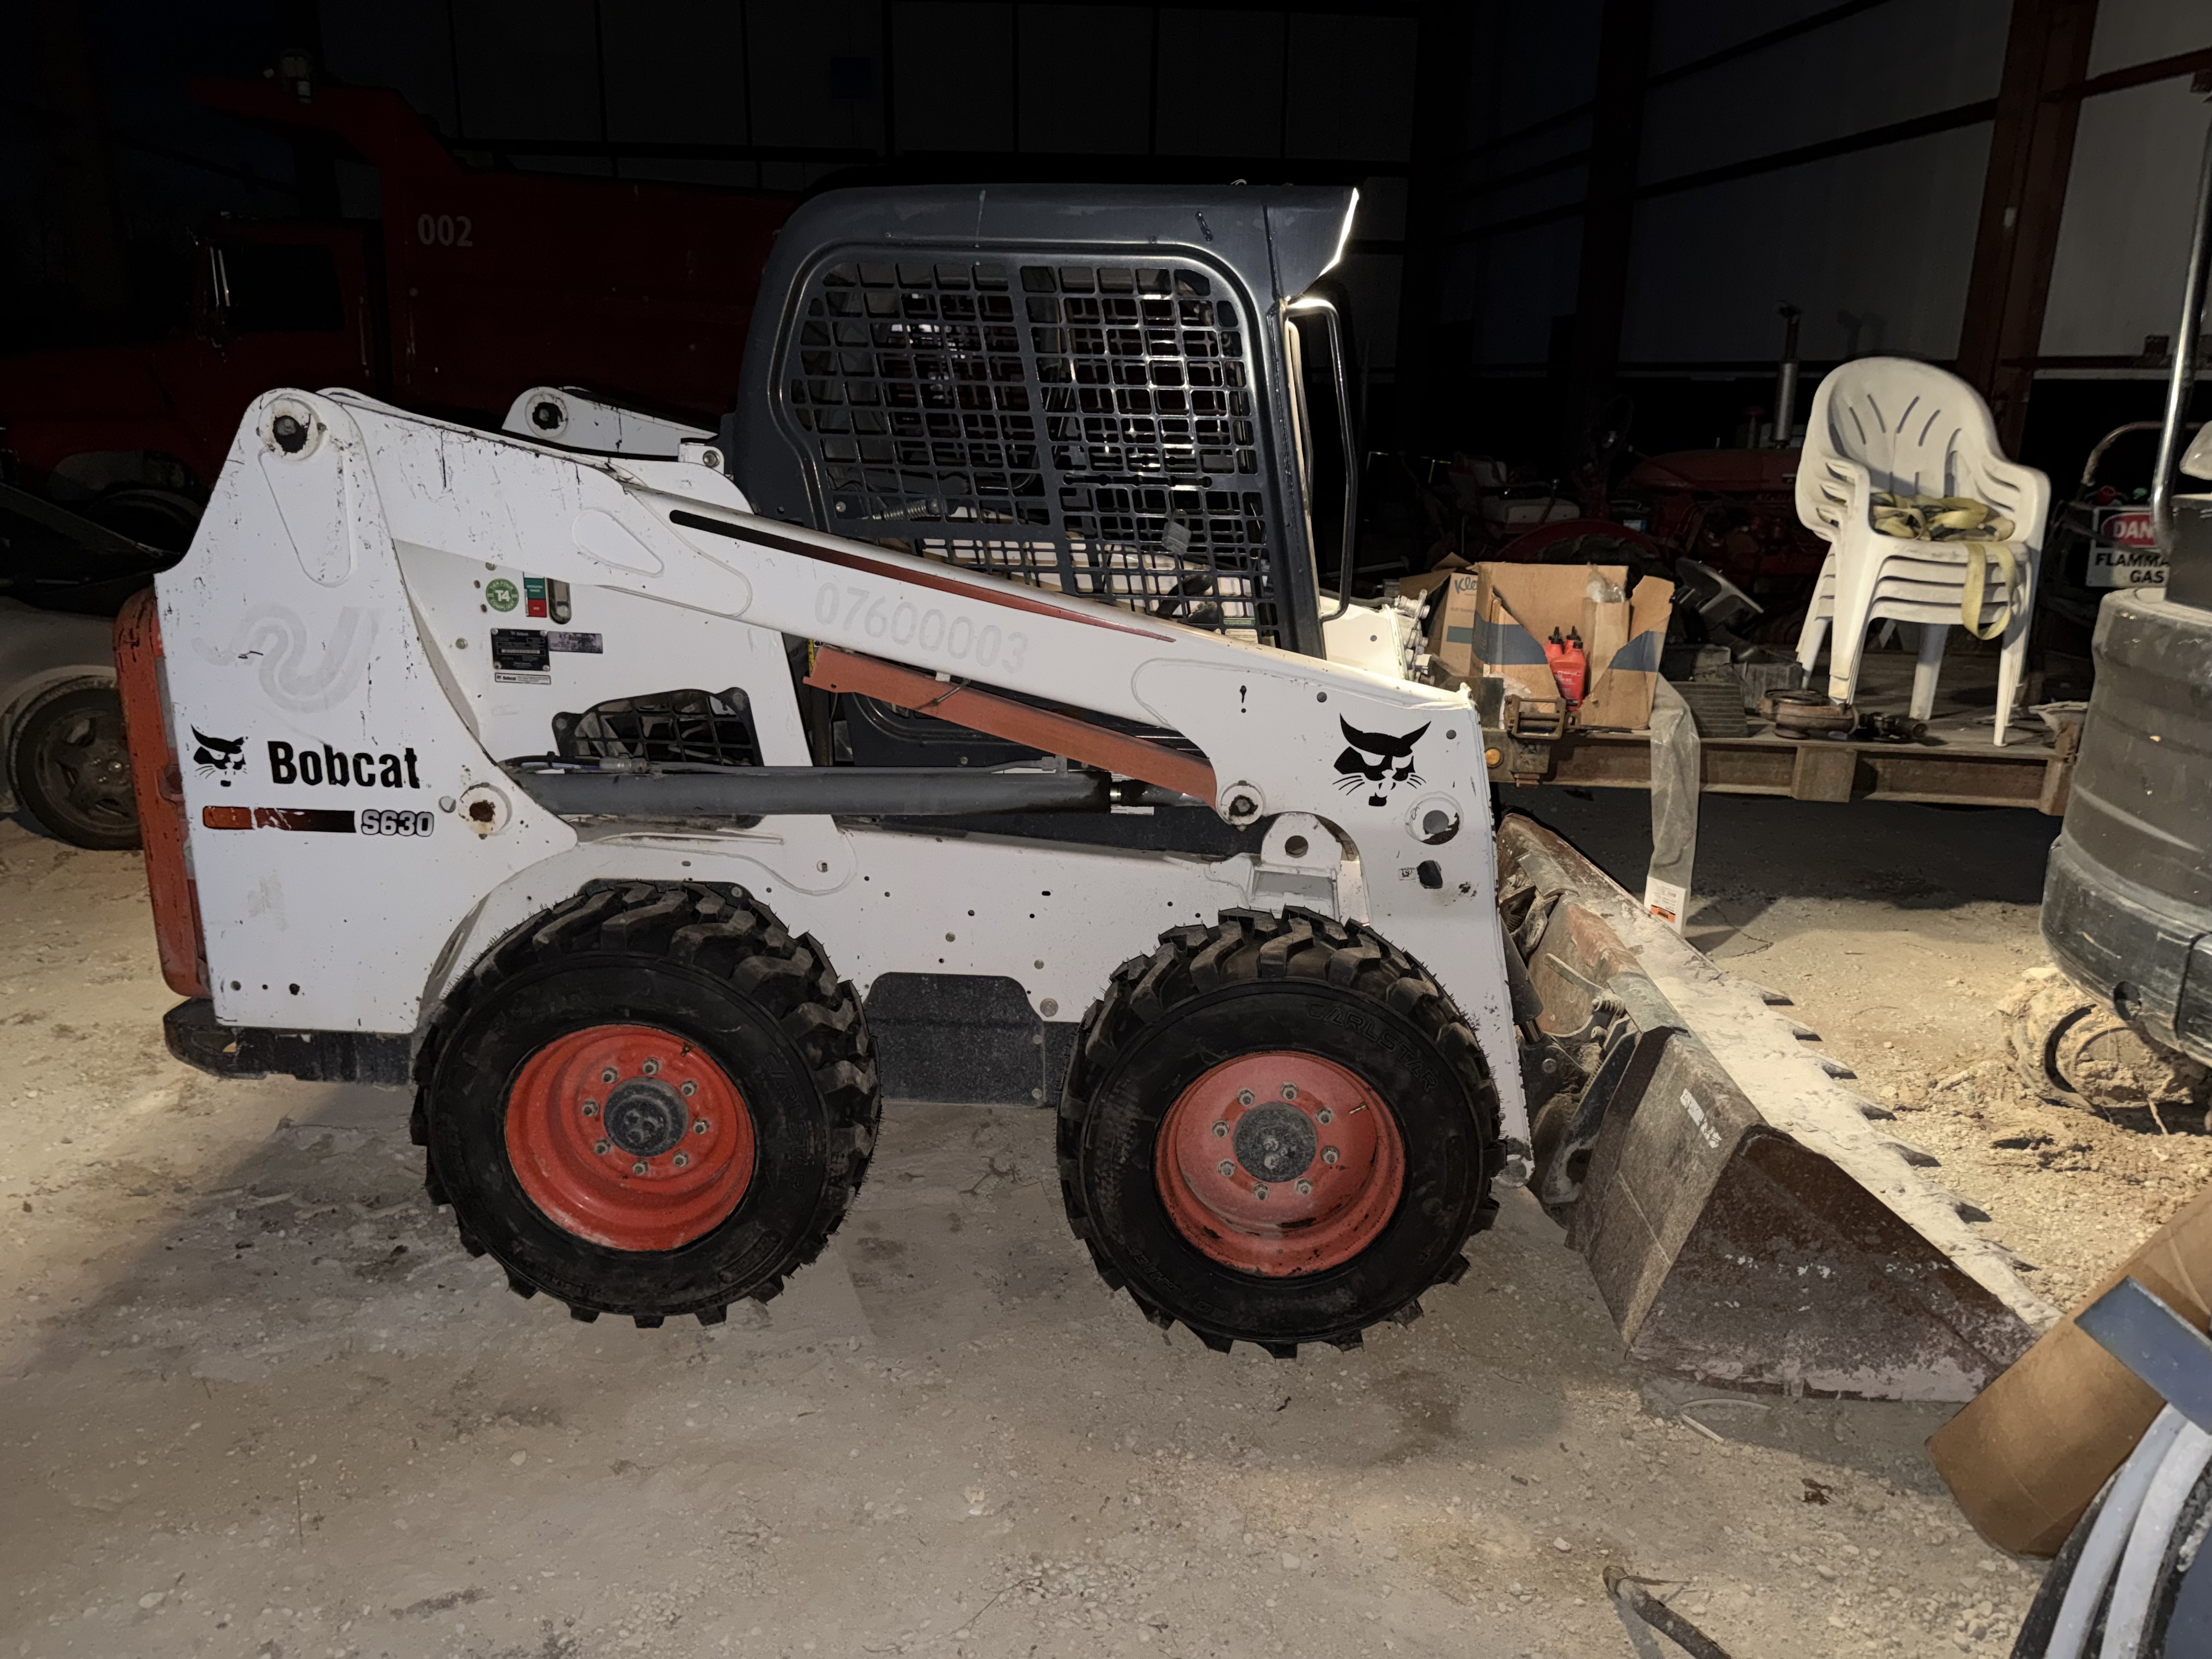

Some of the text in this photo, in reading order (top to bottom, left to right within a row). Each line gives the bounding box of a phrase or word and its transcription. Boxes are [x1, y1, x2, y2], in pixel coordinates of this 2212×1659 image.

[418, 214, 472, 246] 002
[2130, 570, 2165, 584] GAS
[495, 590, 511, 602] T4
[815, 583, 1029, 674] 07600003
[267, 741, 420, 788] Bobcat
[361, 809, 434, 837] S630
[1306, 1000, 1438, 1092] CARLSTAR
